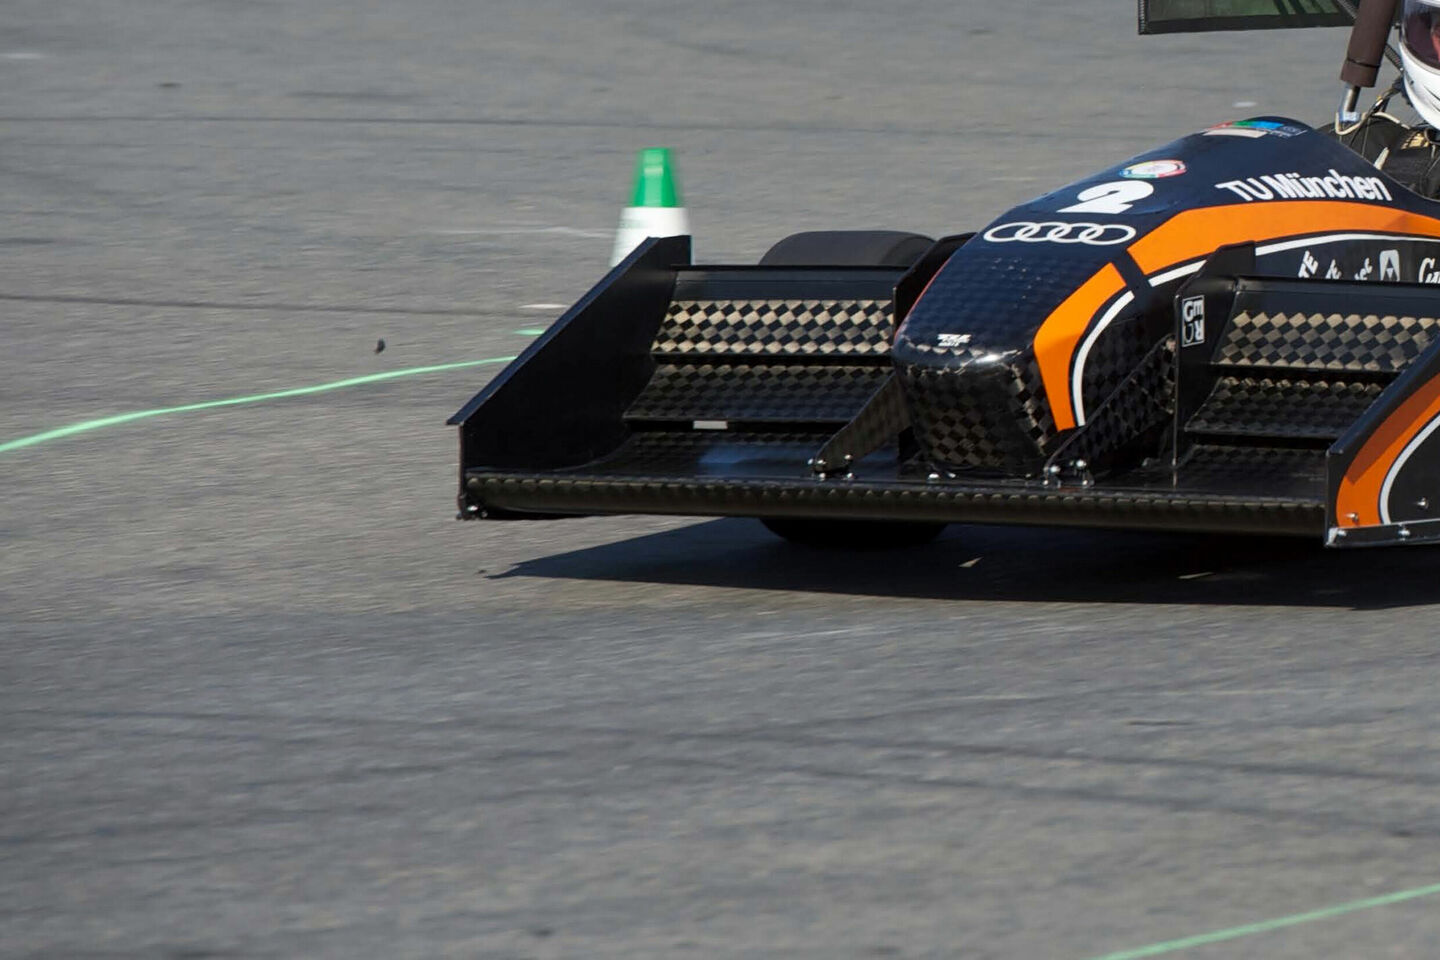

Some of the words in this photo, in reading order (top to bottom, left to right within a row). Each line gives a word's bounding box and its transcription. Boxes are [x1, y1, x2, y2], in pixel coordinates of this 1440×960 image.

[1056, 180, 1154, 214] 2
[1214, 176, 1274, 201] TU
[1272, 169, 1392, 202] München
